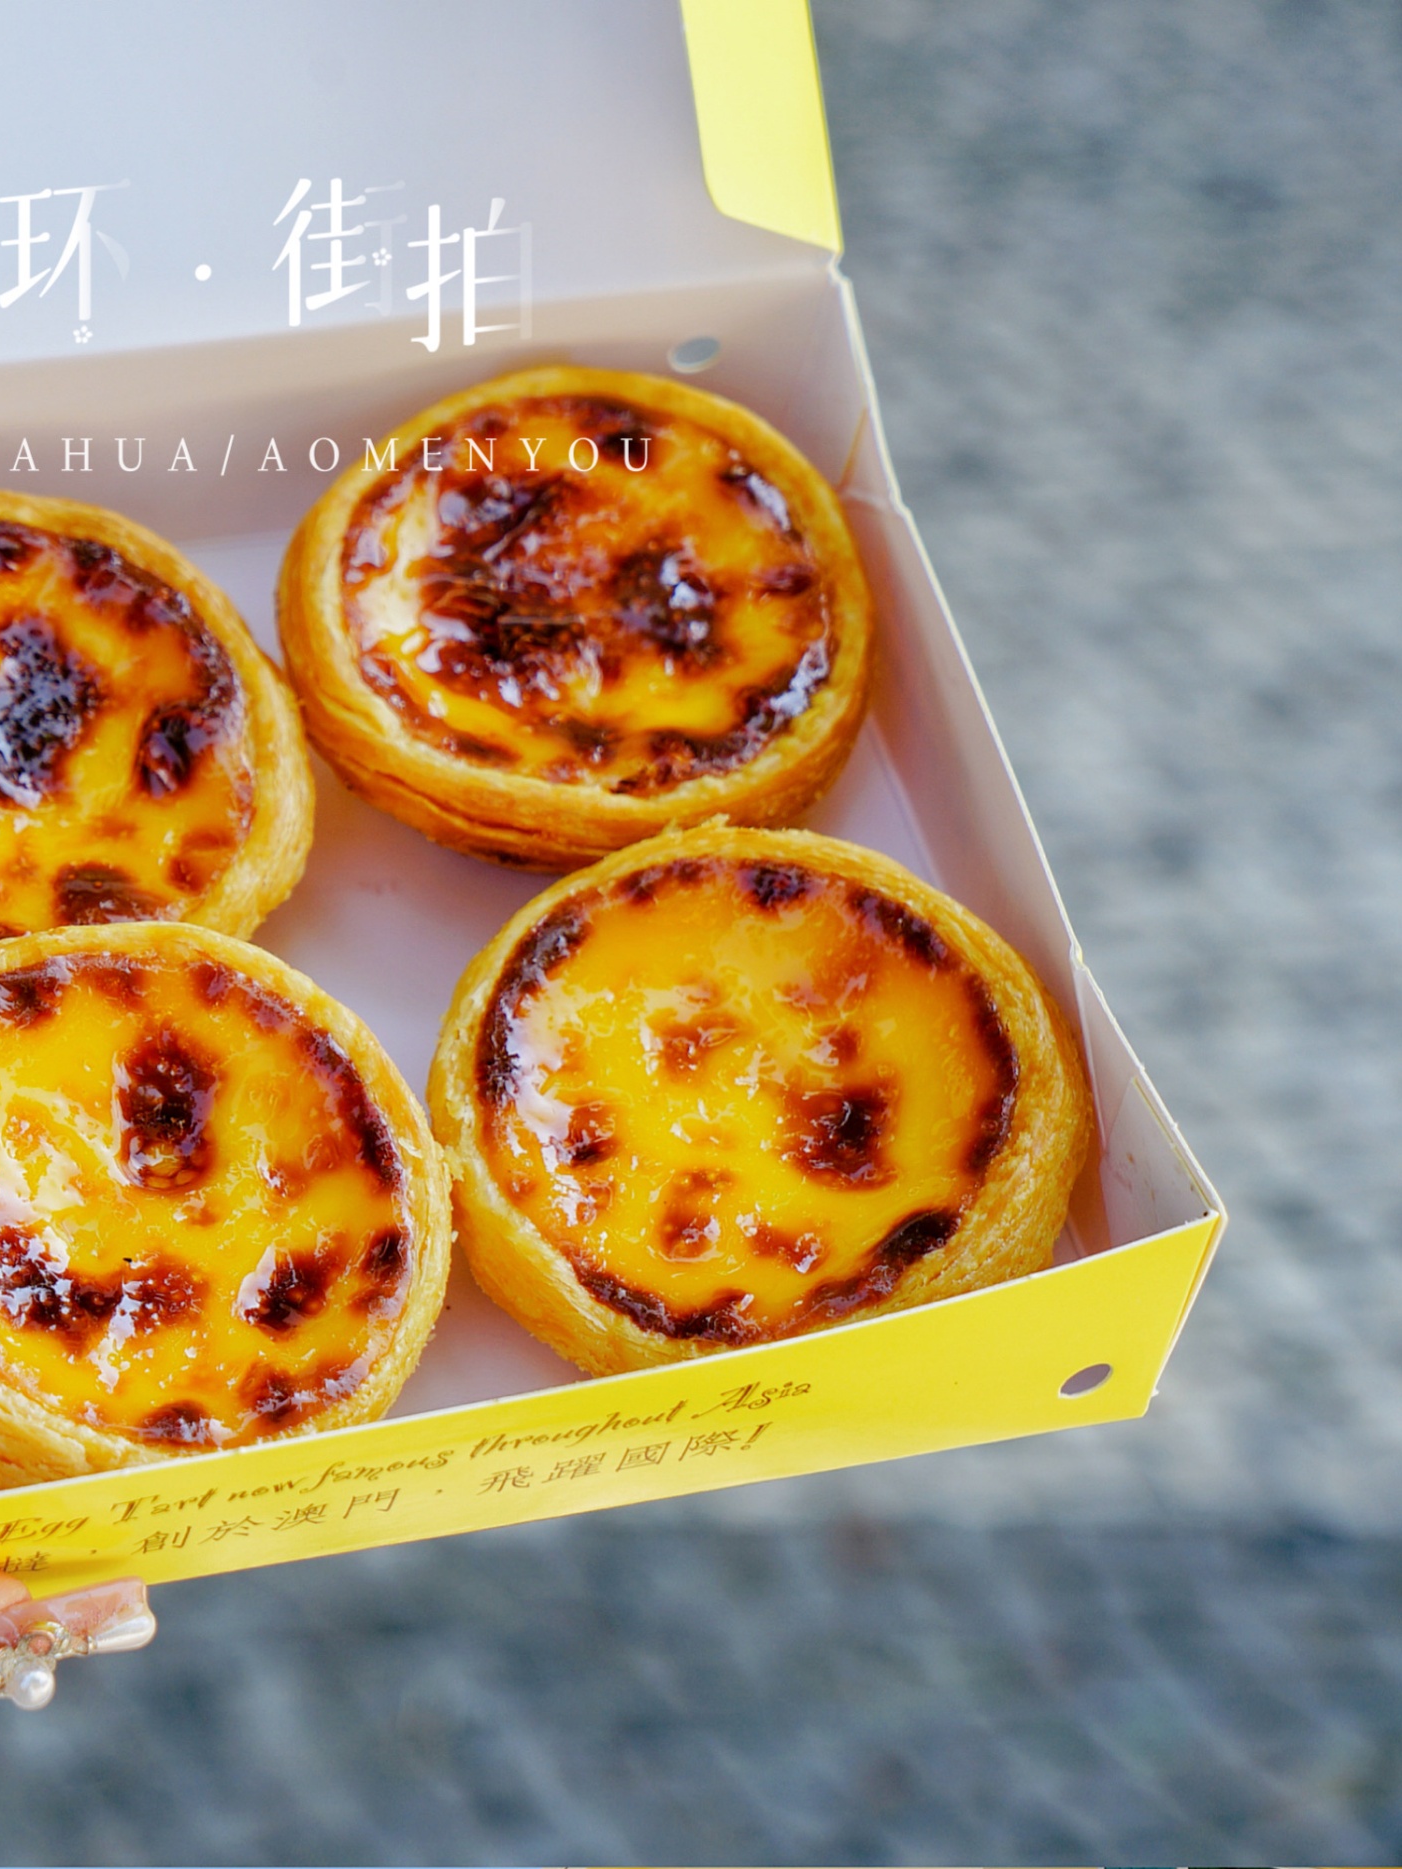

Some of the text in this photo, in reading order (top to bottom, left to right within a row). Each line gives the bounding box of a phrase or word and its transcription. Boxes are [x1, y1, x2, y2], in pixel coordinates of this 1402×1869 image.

[110, 1487, 218, 1526] Tart
[227, 1476, 304, 1502] now
[298, 1448, 455, 1493] famous
[470, 1399, 689, 1461] throughout
[692, 1380, 812, 1420] Asia
